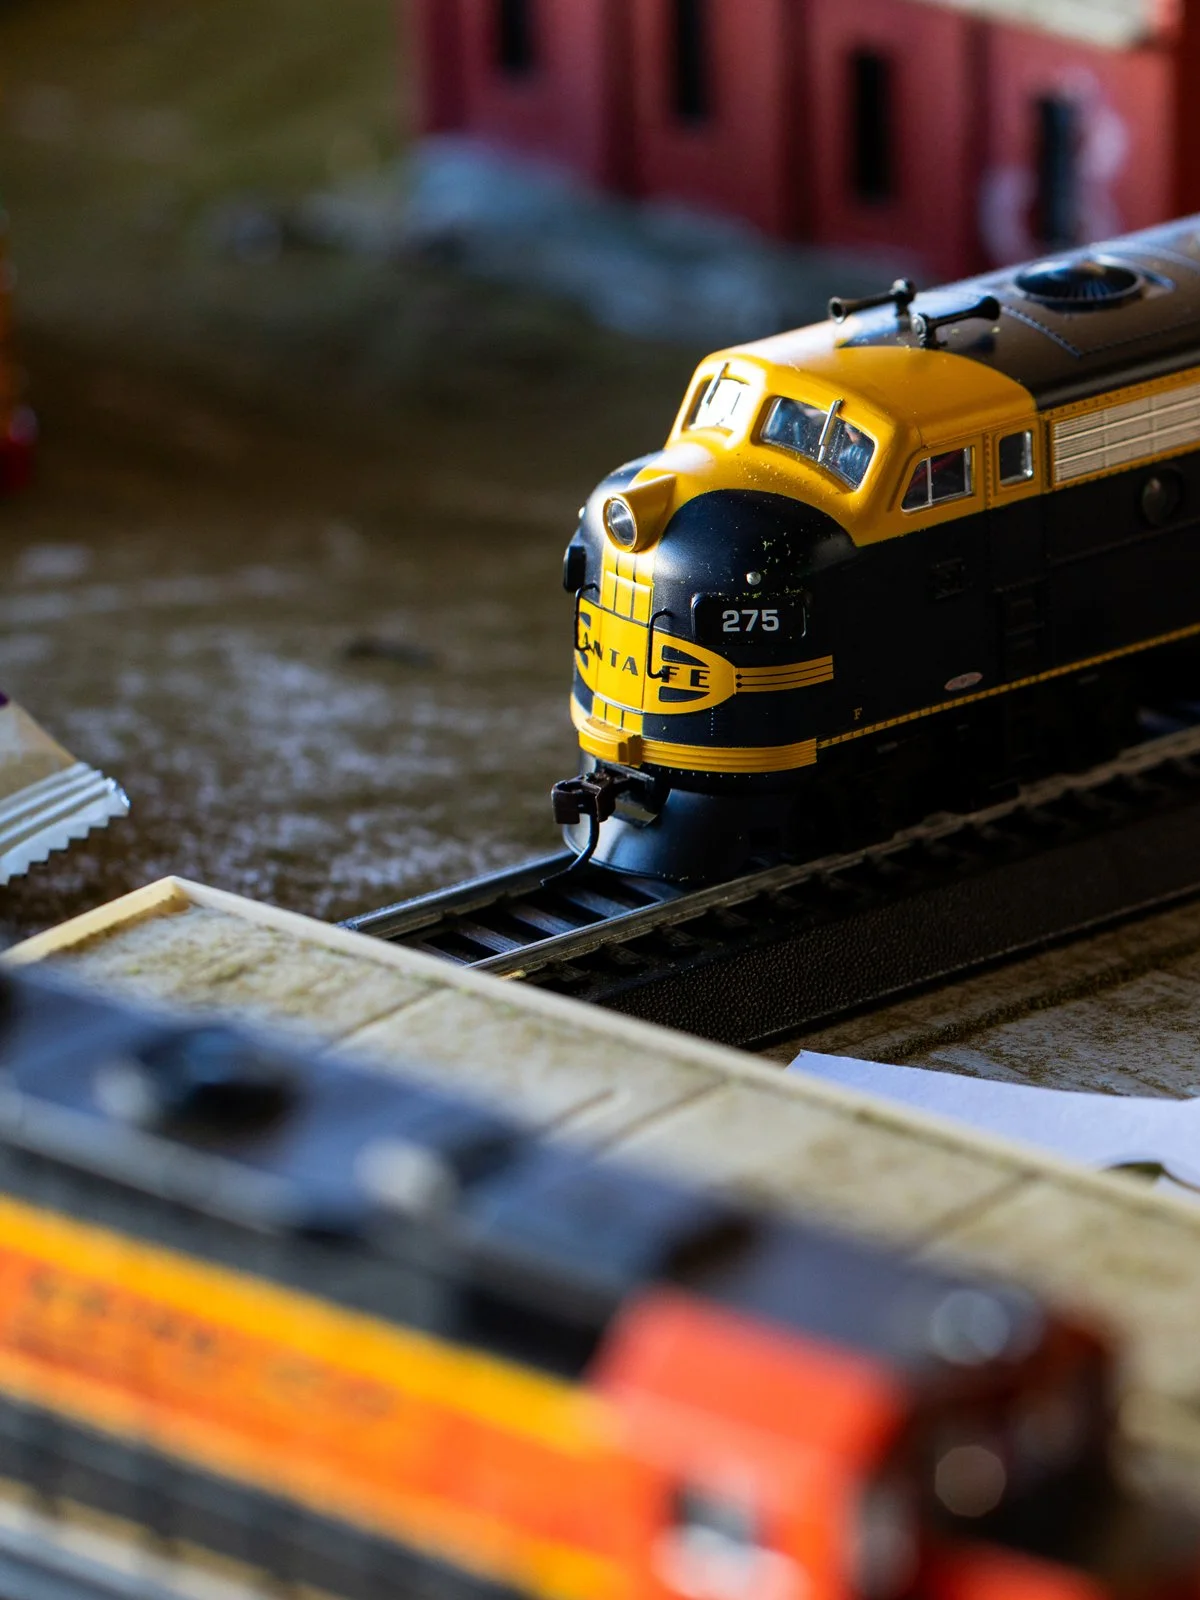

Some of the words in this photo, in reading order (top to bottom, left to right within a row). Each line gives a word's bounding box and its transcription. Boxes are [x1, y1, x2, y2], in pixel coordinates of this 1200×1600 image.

[722, 609, 780, 632] 275
[577, 630, 639, 677] ANTA
[660, 664, 711, 689] FE
[853, 706, 863, 721] F
